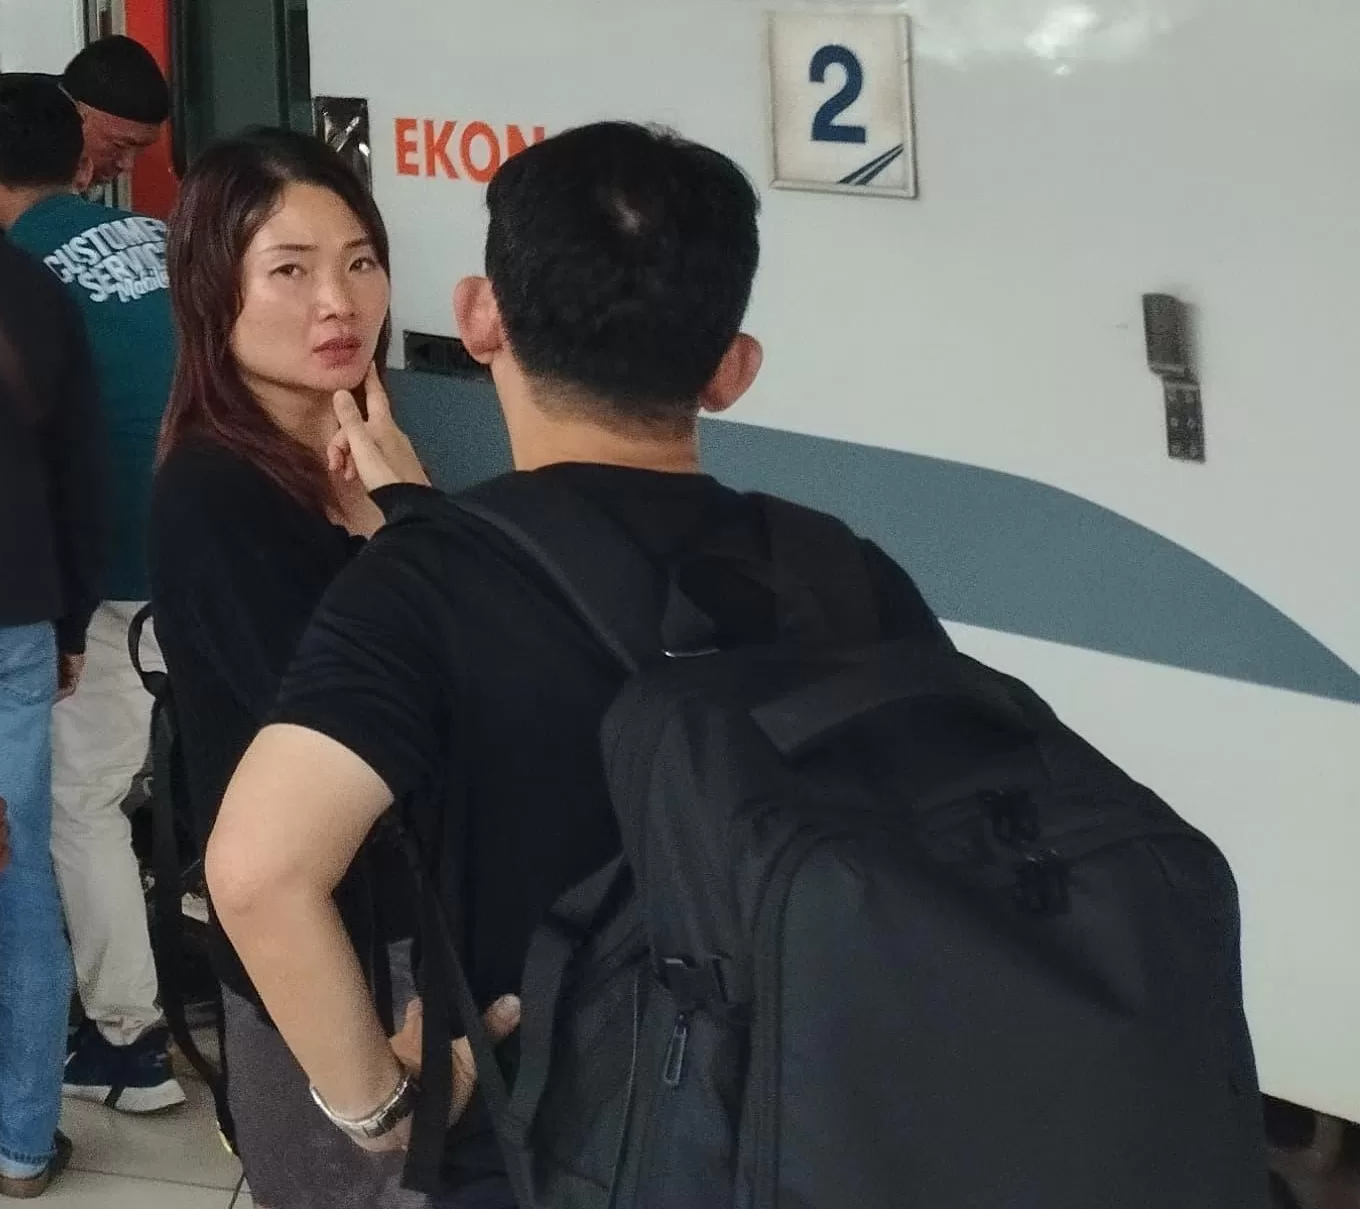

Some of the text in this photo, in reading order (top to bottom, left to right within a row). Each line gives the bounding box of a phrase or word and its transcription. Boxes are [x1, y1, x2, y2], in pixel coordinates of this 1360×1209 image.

[809, 44, 866, 145] 2
[43, 216, 168, 284] CUSTOME
[77, 242, 168, 303] SERVIC
